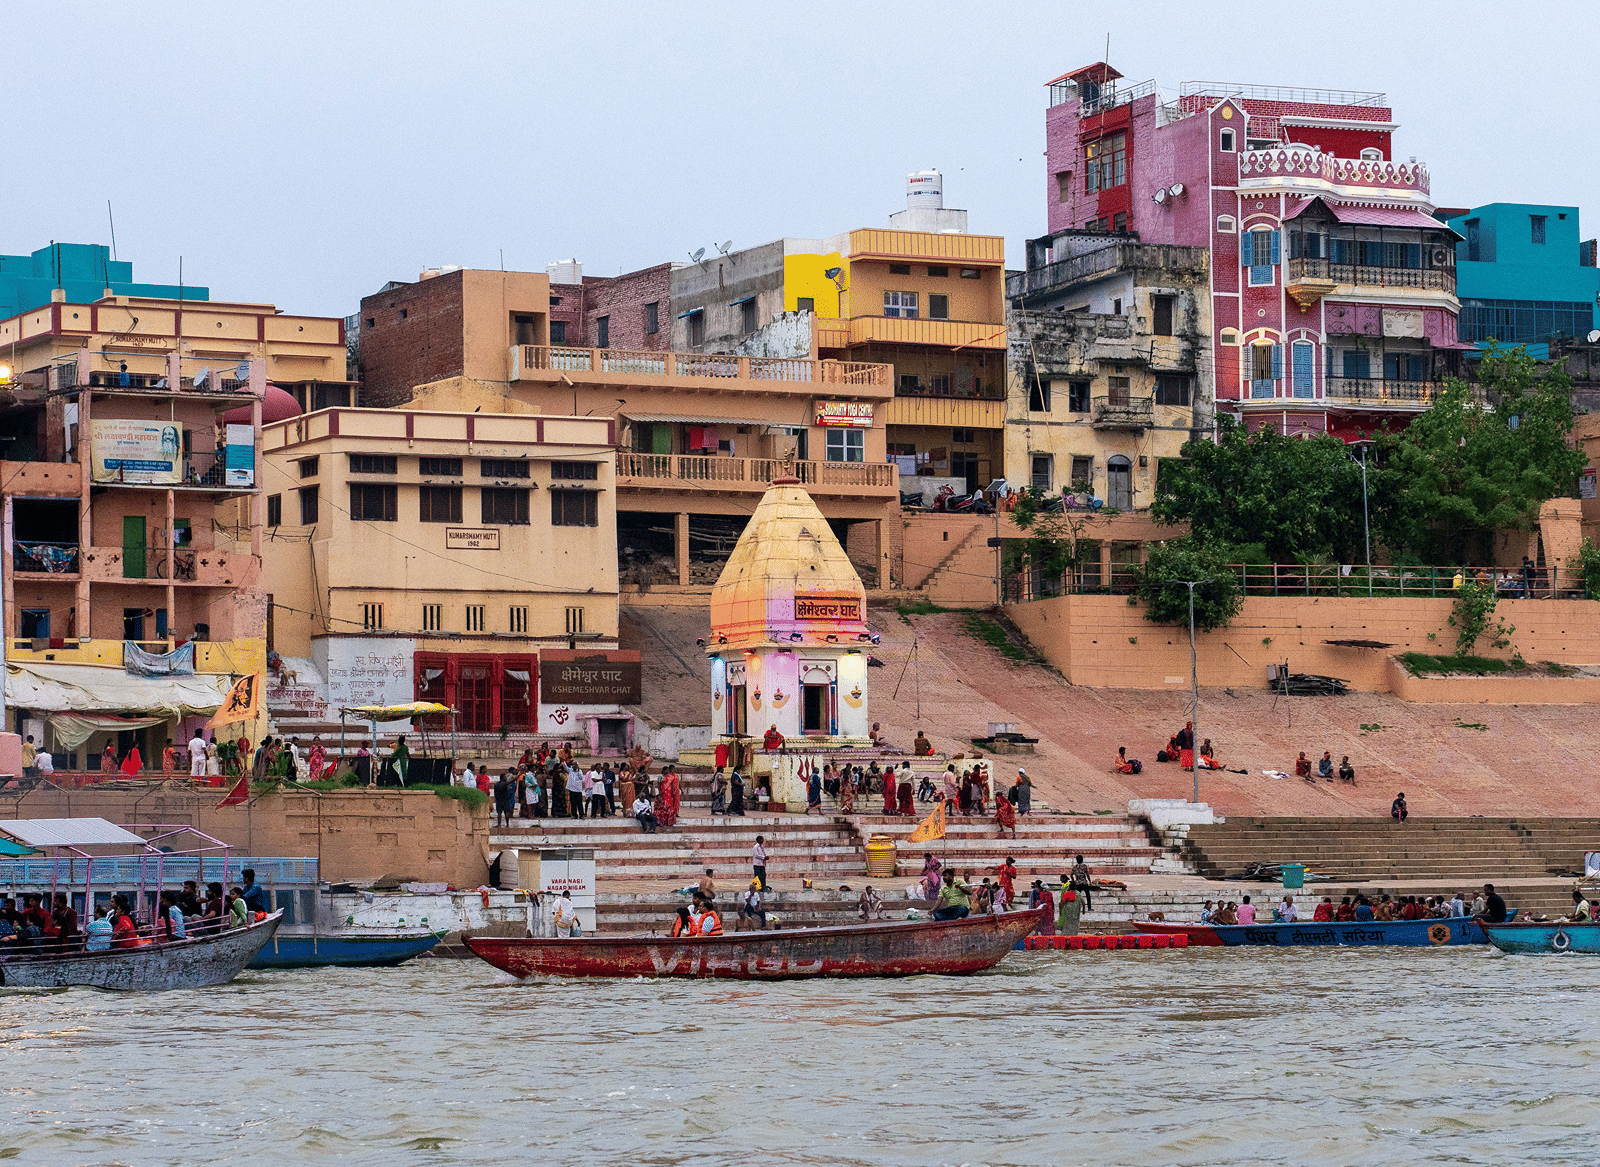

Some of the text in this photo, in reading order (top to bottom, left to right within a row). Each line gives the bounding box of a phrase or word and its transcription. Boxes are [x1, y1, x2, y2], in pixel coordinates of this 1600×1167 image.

[848, 403, 858, 417] YOGA
[858, 403, 873, 418] CENTRE
[840, 605, 858, 617] घाट
[561, 666, 623, 683] क्षेमेश्वर घाट
[551, 685, 632, 694] KSHEMESHVAR GHAT
[1292, 929, 1336, 944] टीएमटी
[1342, 928, 1386, 943] सरिया
